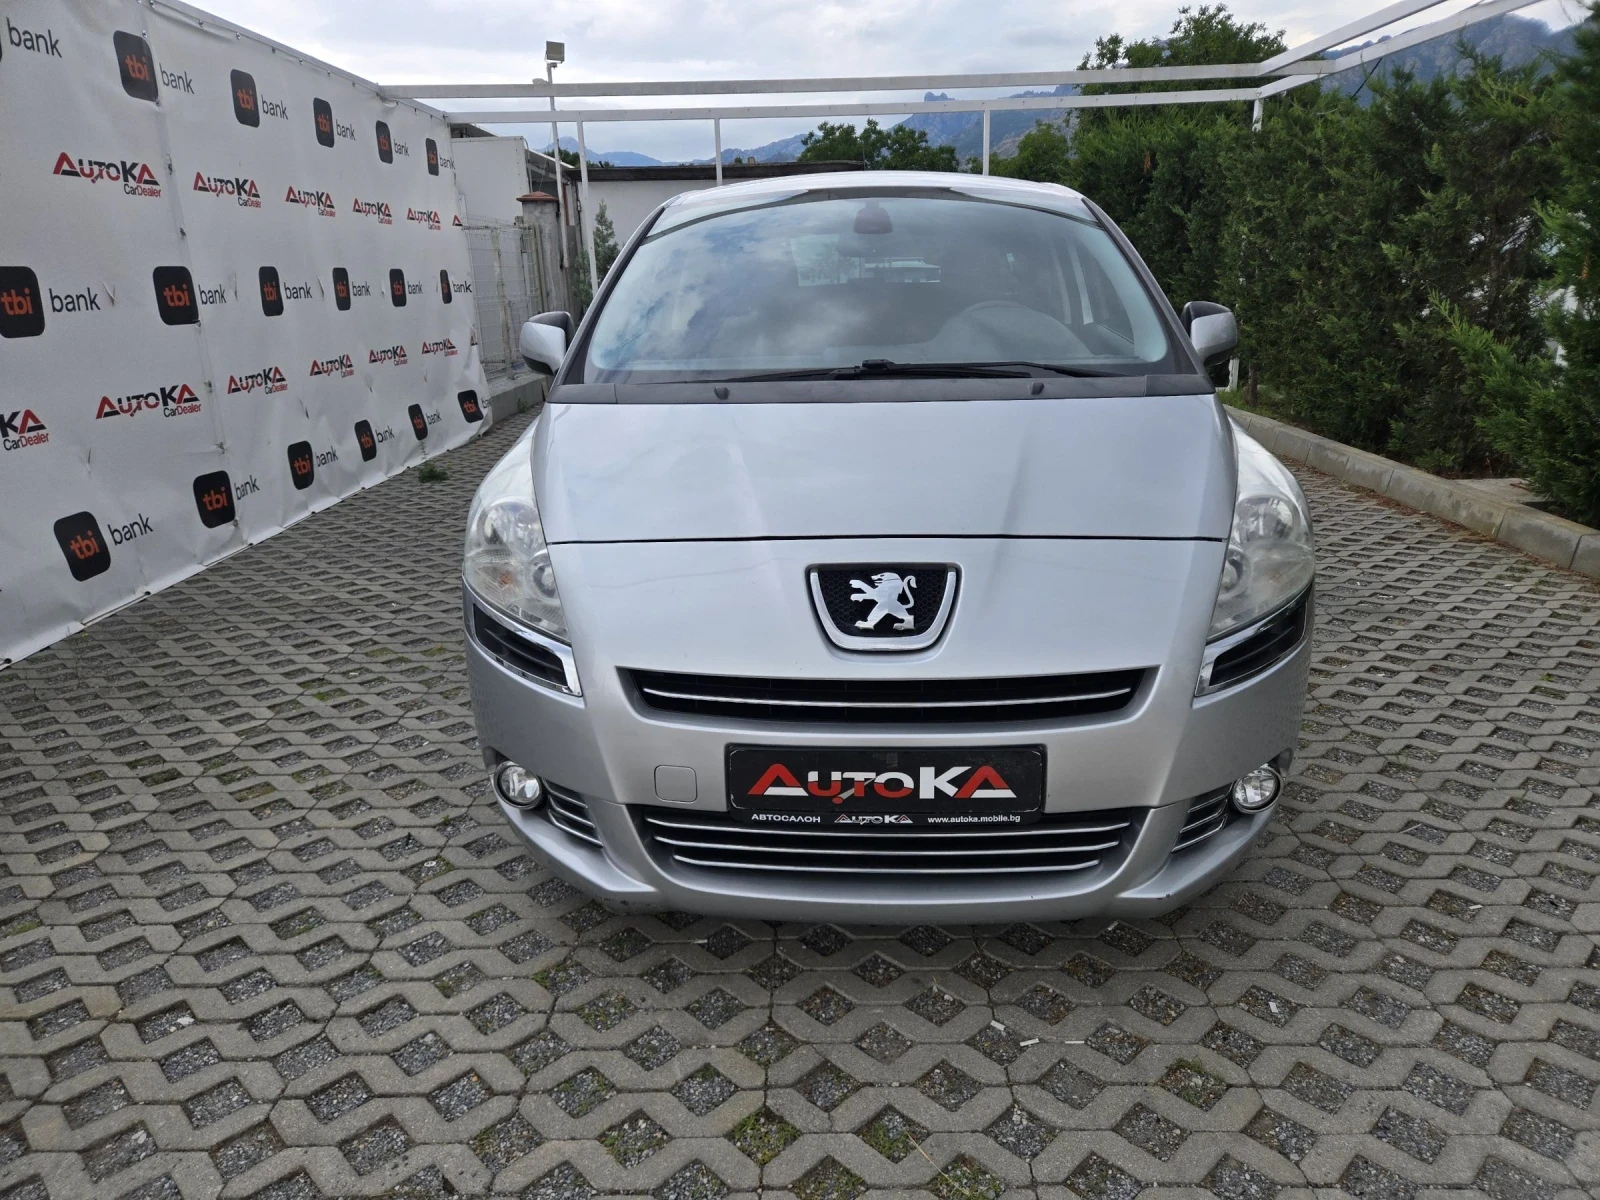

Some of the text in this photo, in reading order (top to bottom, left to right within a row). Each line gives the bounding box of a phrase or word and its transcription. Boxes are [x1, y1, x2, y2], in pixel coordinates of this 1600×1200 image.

[6, 16, 63, 58] bank
[125, 54, 195, 94] tbi bank
[237, 88, 289, 120] tbi bank
[336, 119, 356, 141] bank
[394, 139, 410, 157] bank
[163, 283, 227, 307] tbi bank
[284, 281, 313, 299] bank
[352, 280, 371, 297] bank
[407, 281, 423, 295] bank
[451, 280, 473, 293] bank
[1, 287, 101, 316] tbi bank
[163, 403, 202, 418] CarDealer
[425, 410, 442, 425] bank
[3, 432, 50, 451] CarDealer
[294, 446, 339, 475] tbi bank
[202, 475, 261, 511] tbi bank
[70, 513, 154, 560] tbi bank
[751, 813, 821, 823] АВТОСАЛОН
[927, 814, 1021, 824] www.autoka.mobile.bg
